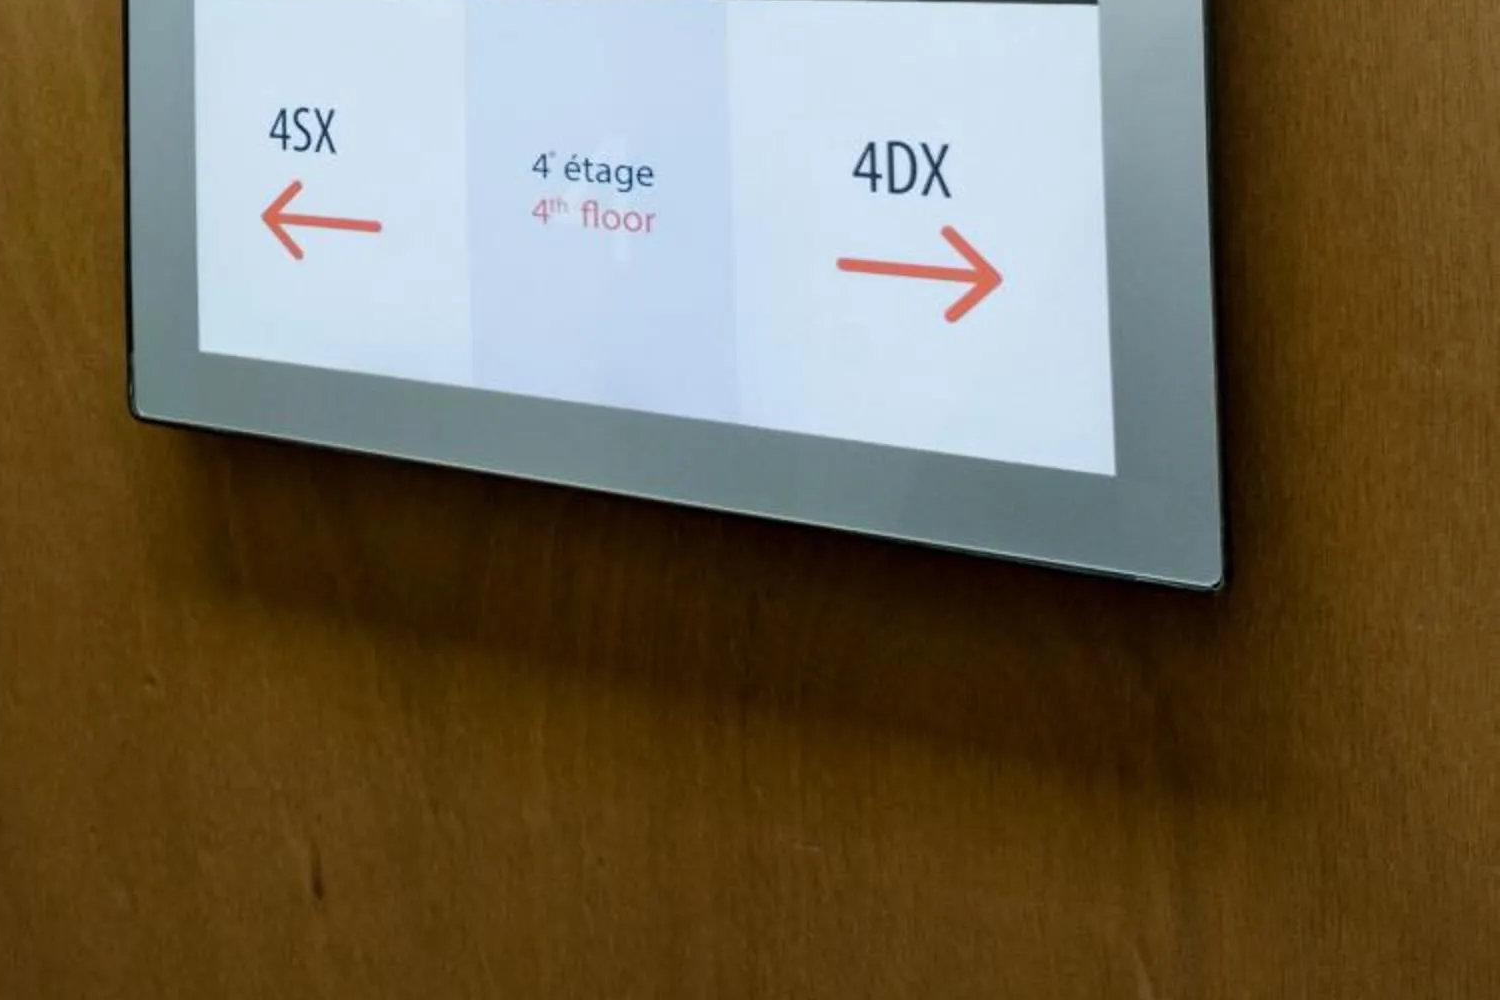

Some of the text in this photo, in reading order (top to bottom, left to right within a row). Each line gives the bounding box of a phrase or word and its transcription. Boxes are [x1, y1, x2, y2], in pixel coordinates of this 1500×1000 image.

[269, 106, 337, 154] 4SX
[564, 153, 655, 193] étage
[852, 140, 952, 199] 4DX
[531, 197, 657, 234] 4th floor
